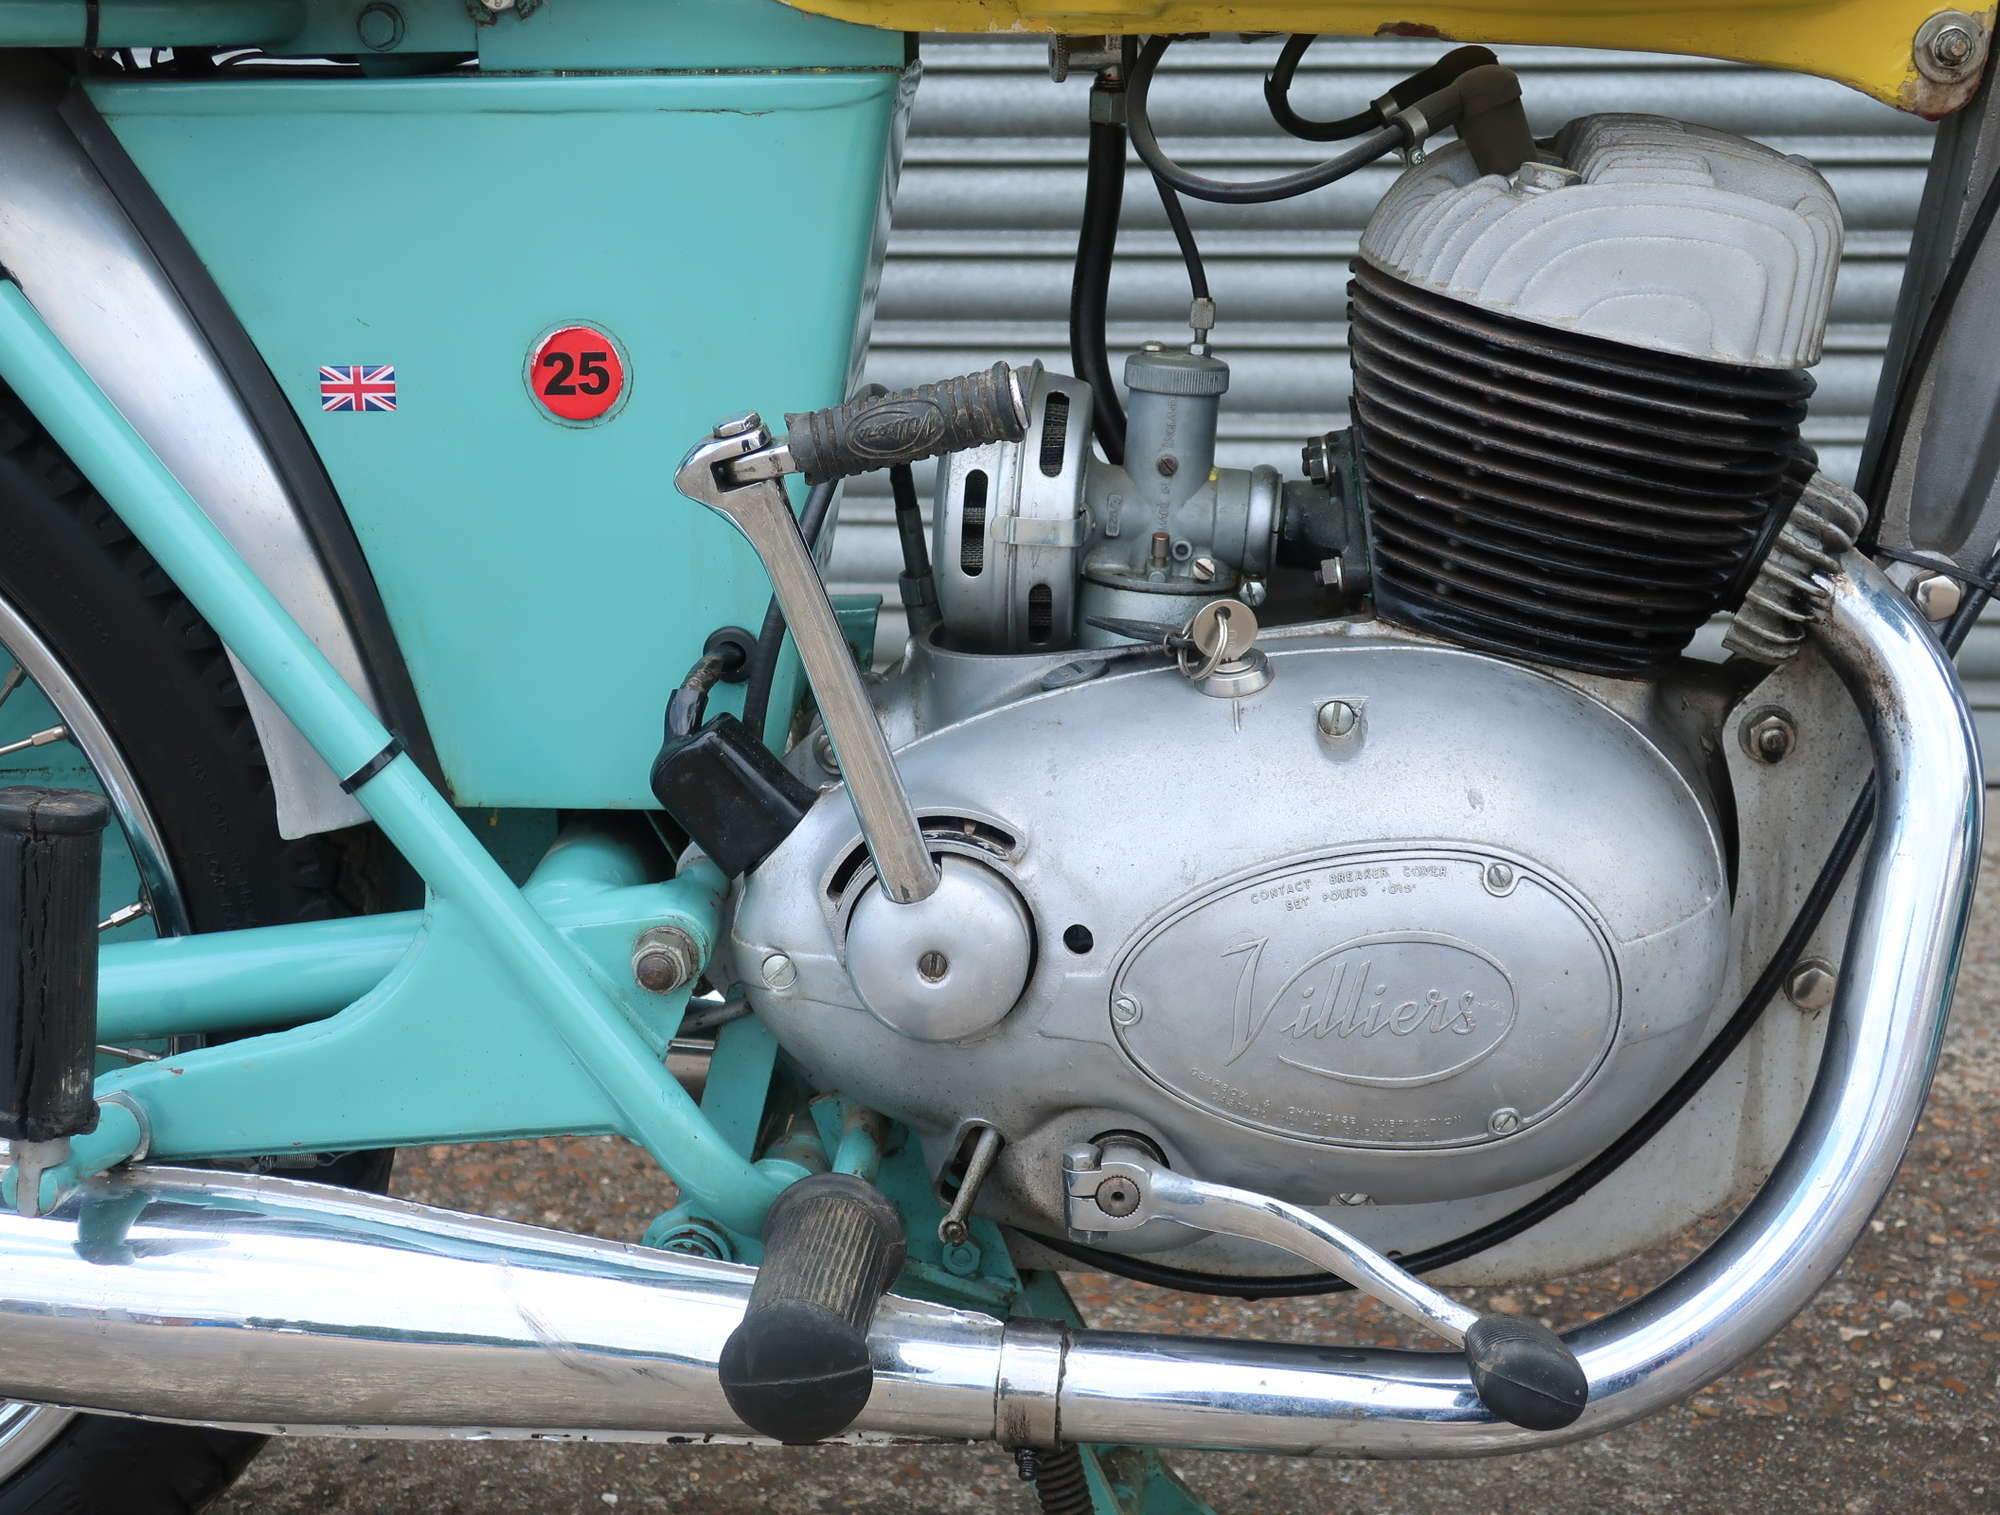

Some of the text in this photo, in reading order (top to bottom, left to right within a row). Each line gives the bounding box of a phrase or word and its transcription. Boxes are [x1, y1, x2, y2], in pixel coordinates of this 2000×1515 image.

[543, 351, 610, 395] 25
[1250, 865, 1448, 905] CONTACT BREAKER COVER
[1286, 896, 1311, 912] SET
[1322, 887, 1369, 903] POINTS
[1220, 936, 1480, 1067] Villiers
